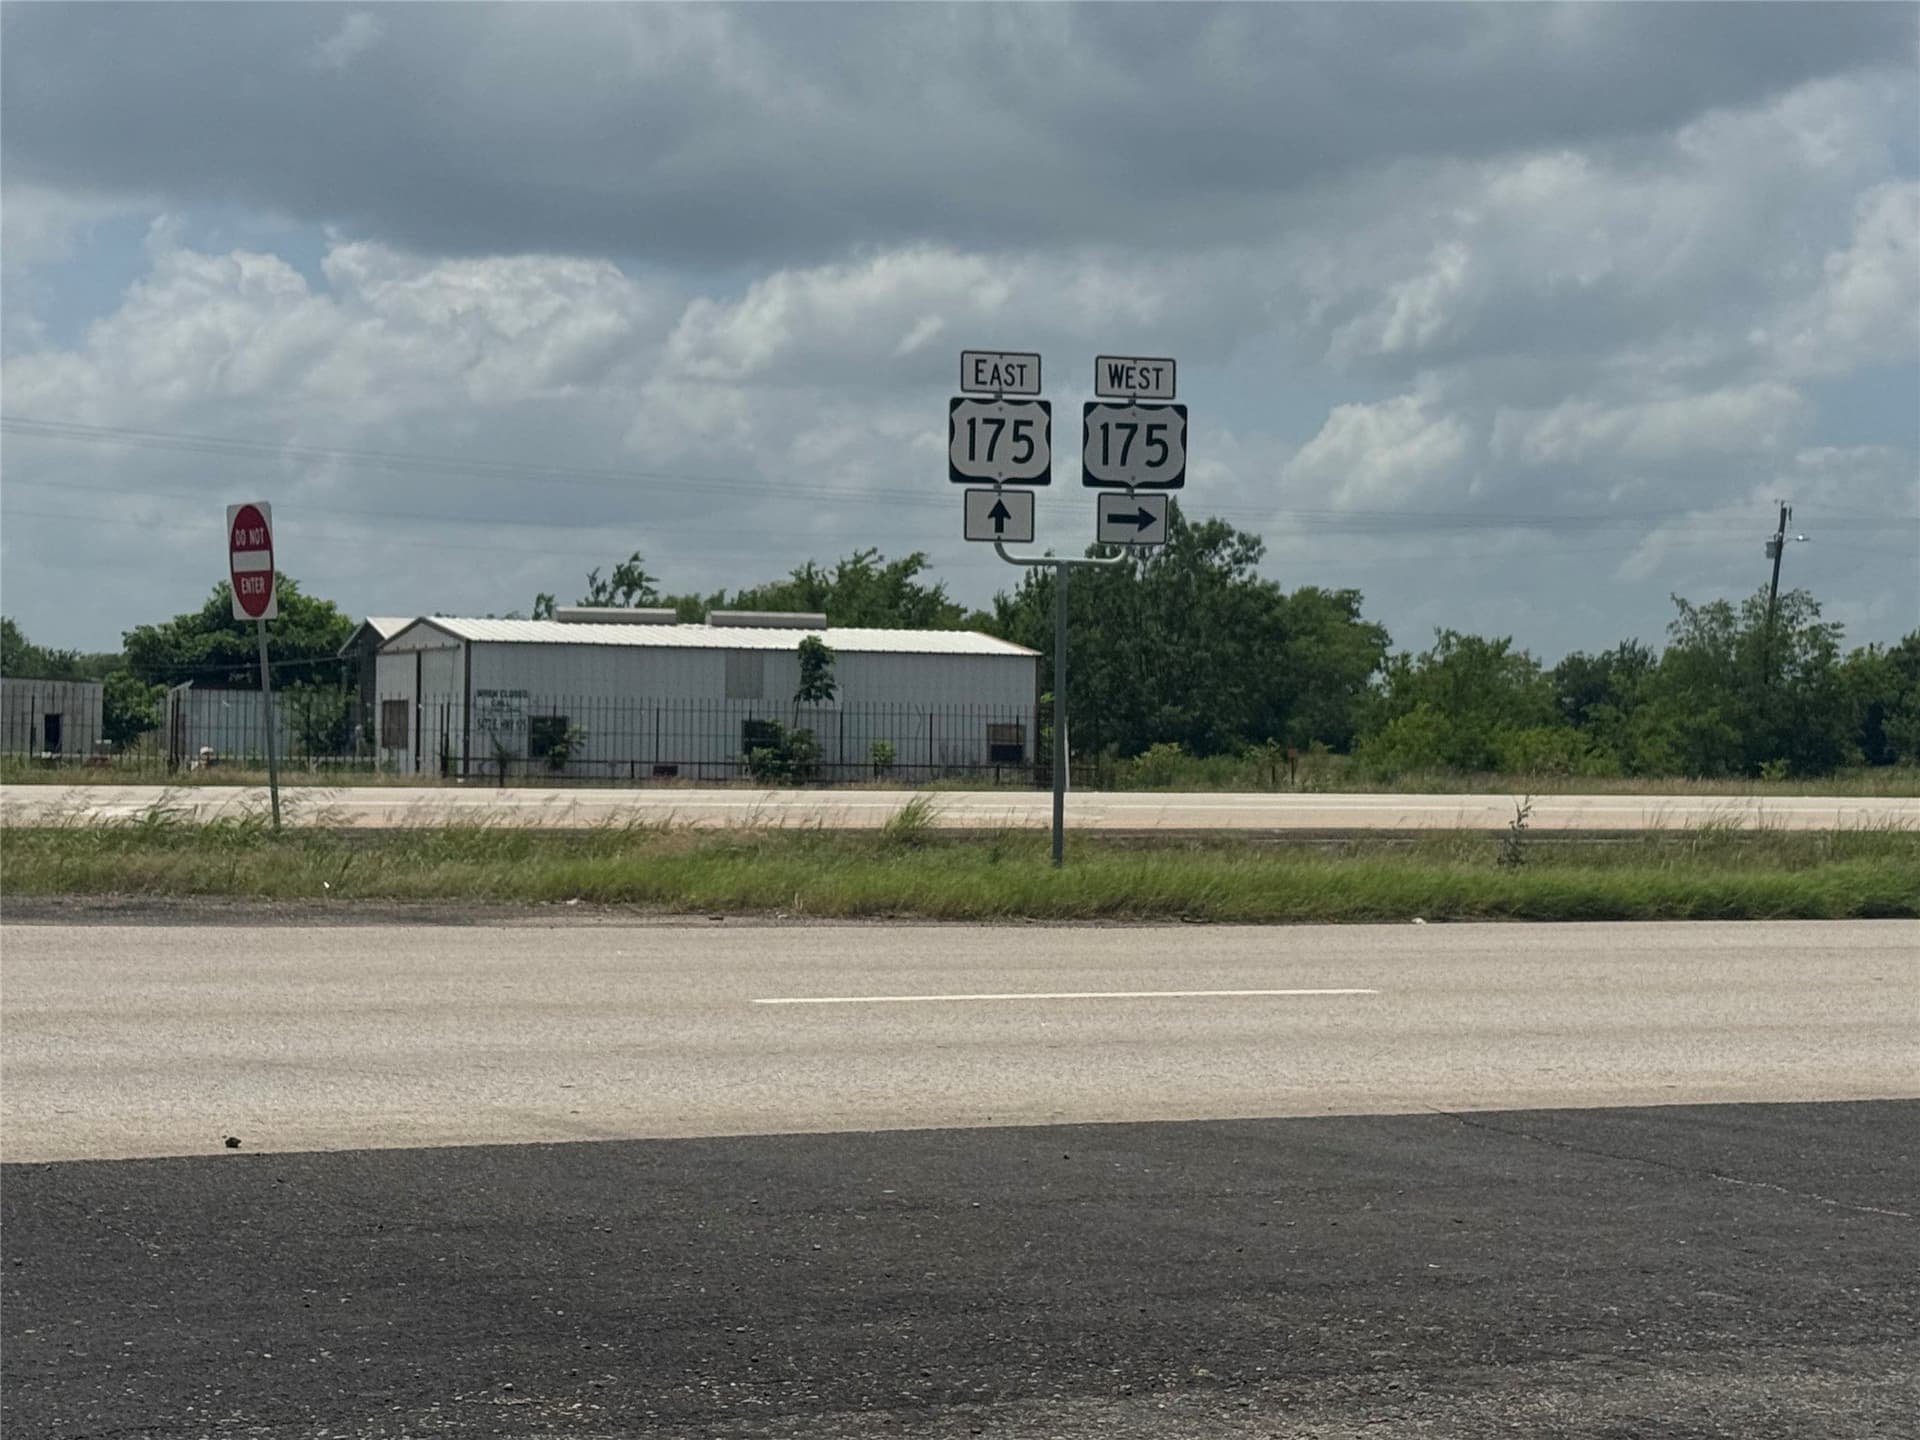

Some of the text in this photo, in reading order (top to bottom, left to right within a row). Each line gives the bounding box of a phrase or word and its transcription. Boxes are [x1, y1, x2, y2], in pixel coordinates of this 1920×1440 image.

[975, 359, 1027, 387] EAST
[1108, 363, 1164, 390] WEST
[967, 417, 1035, 464] 175
[1100, 422, 1169, 468] 175
[235, 528, 264, 546] DO NOT
[241, 577, 264, 594] ENTER
